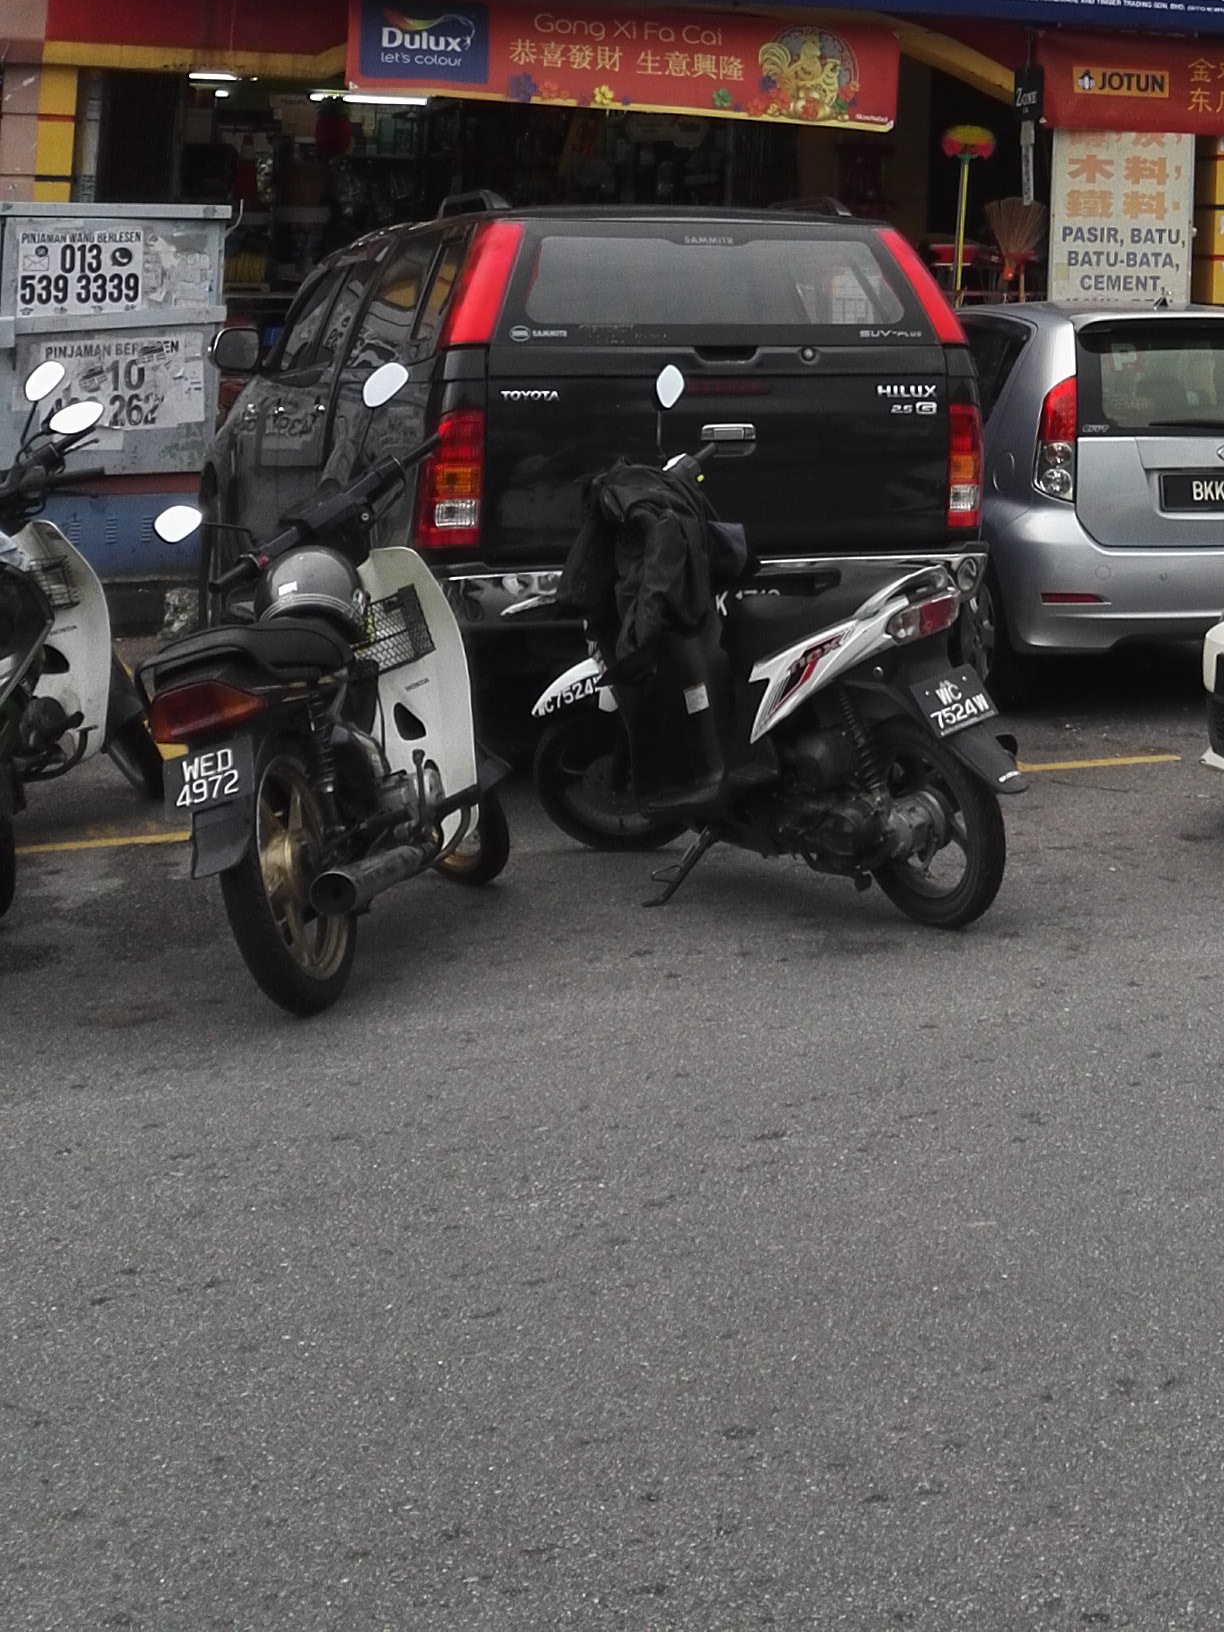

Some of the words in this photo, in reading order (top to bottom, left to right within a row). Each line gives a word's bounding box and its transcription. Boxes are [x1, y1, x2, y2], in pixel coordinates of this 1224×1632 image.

[382, 27, 461, 52] Dulux
[534, 13, 606, 41] Gong
[612, 20, 637, 40] Xi
[644, 22, 675, 43] Fa
[682, 24, 722, 46] Cai
[381, 52, 410, 64] let's
[414, 55, 462, 66] colour
[510, 38, 623, 72] 恭喜發財
[636, 49, 744, 82] 生意興隆
[1098, 71, 1165, 93] JOTUN
[21, 232, 67, 244] PINJAMAN
[97, 231, 141, 244] BERLESEN
[1062, 226, 1124, 247] PASIR,
[1130, 228, 1186, 248] BATU,
[60, 244, 102, 274] 013
[1067, 250, 1180, 271] BATU-BATA,
[20, 274, 69, 305] 539
[76, 273, 140, 304] 3339
[1080, 274, 1166, 295] CEMENT,
[45, 344, 111, 359] PINJAMAN
[1111, 344, 1138, 371] P
[500, 390, 560, 402] TOYOTA
[877, 385, 936, 397] HILUX
[935, 680, 962, 705] WC
[930, 693, 989, 729] 7524W
[180, 748, 234, 782] WED
[176, 771, 240, 807] 4972
